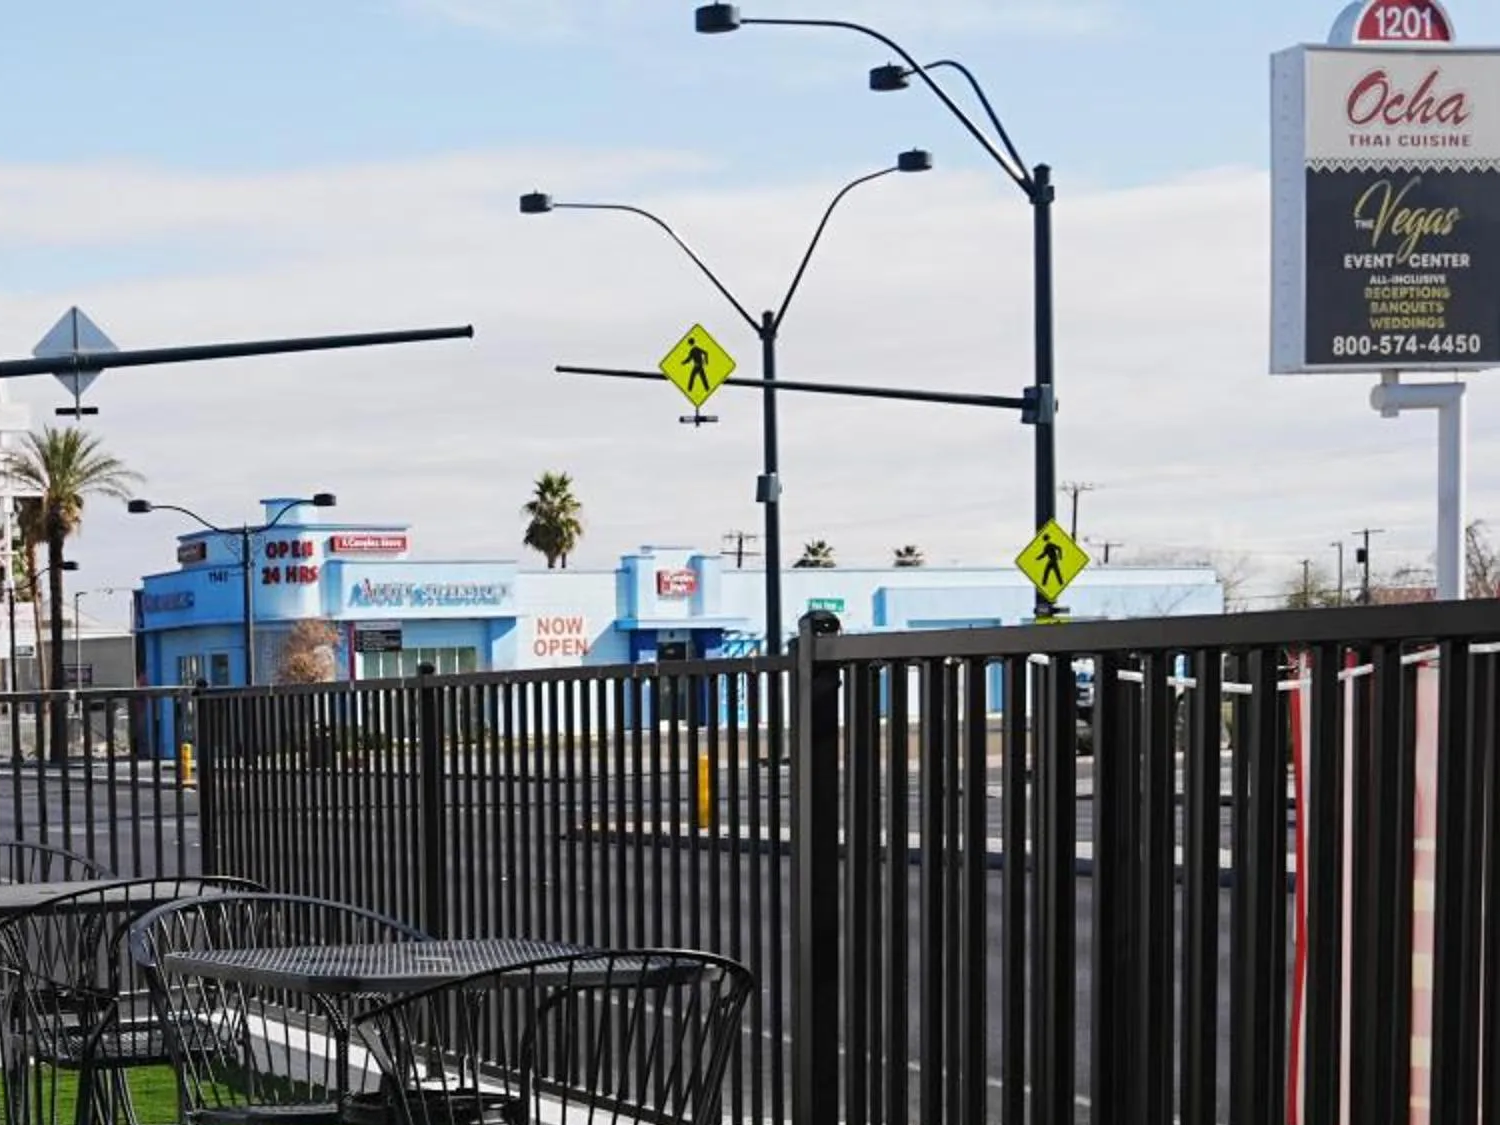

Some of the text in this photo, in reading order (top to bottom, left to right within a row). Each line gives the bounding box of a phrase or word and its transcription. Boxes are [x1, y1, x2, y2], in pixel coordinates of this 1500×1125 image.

[1375, 6, 1432, 38] 1201
[1347, 69, 1469, 125] Ocha
[1349, 134, 1471, 147] THAI CUISINE
[1353, 175, 1460, 265] Vegas
[1344, 253, 1470, 269] EVENT CENTER
[1369, 274, 1446, 285] ALL-INCLUSIVE
[1364, 287, 1451, 299] RECEPTIONS
[1370, 301, 1444, 314] BANQUETS
[1369, 316, 1445, 329] WEDDINGS
[1333, 334, 1480, 356] 800-574-4450
[265, 540, 313, 558] OPEN
[261, 565, 318, 585] 24 HRS
[537, 616, 583, 635] NOW
[533, 639, 588, 657] OPEN
